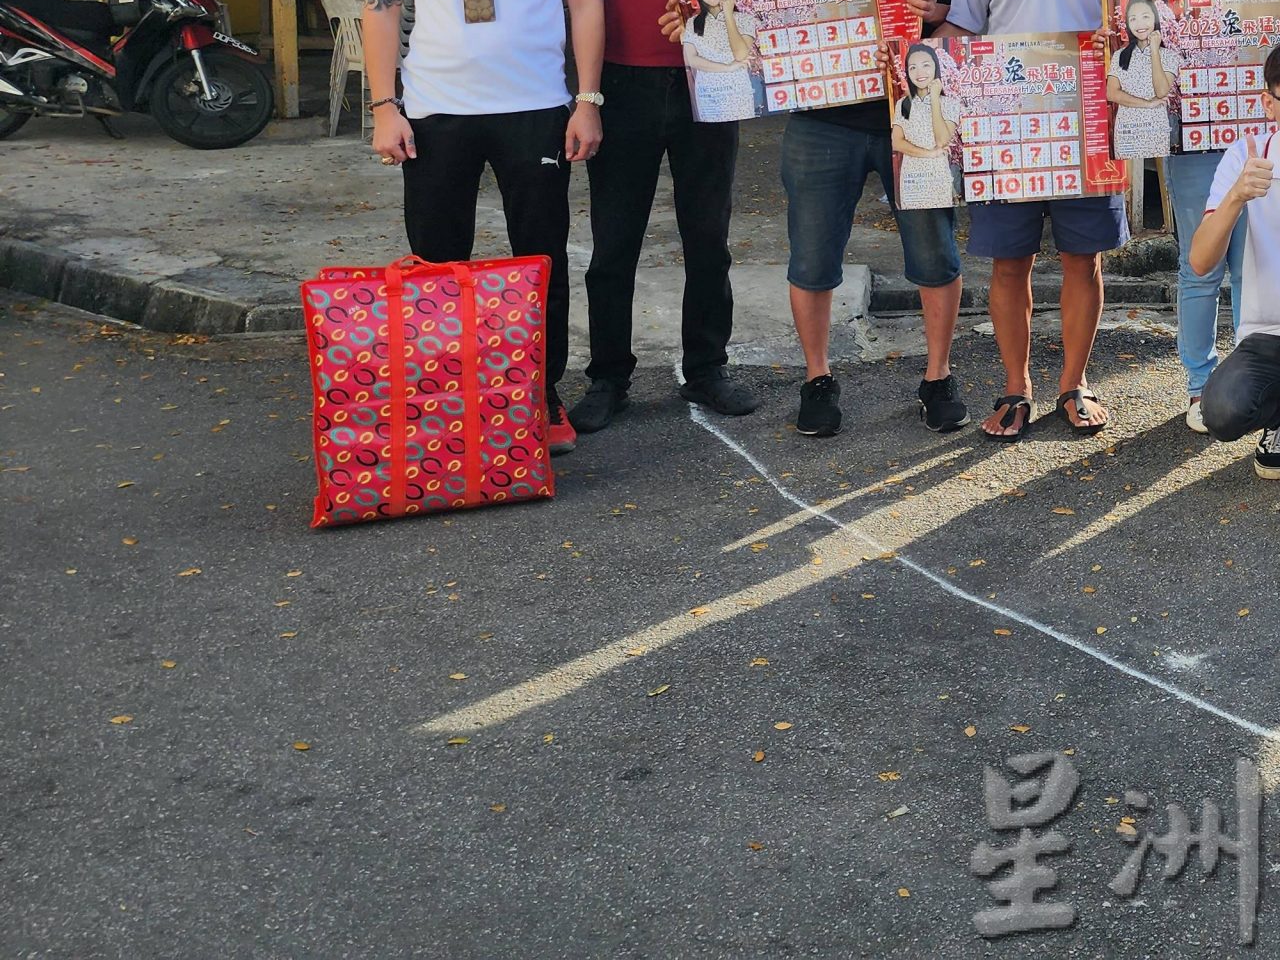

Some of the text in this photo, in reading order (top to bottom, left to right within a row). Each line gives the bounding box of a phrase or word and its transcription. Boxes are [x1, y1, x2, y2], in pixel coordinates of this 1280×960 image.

[767, 22, 869, 49] 1 2 3 4
[1178, 20, 1219, 36] 2023
[769, 50, 871, 78] 5 6 7 8
[960, 66, 1002, 84] 2023
[772, 78, 880, 105] 9 10 11 12
[971, 118, 1071, 136] 1 2 3 4
[971, 145, 1072, 166] 5 6 7 8
[971, 175, 1078, 195] 9 10 11 12
